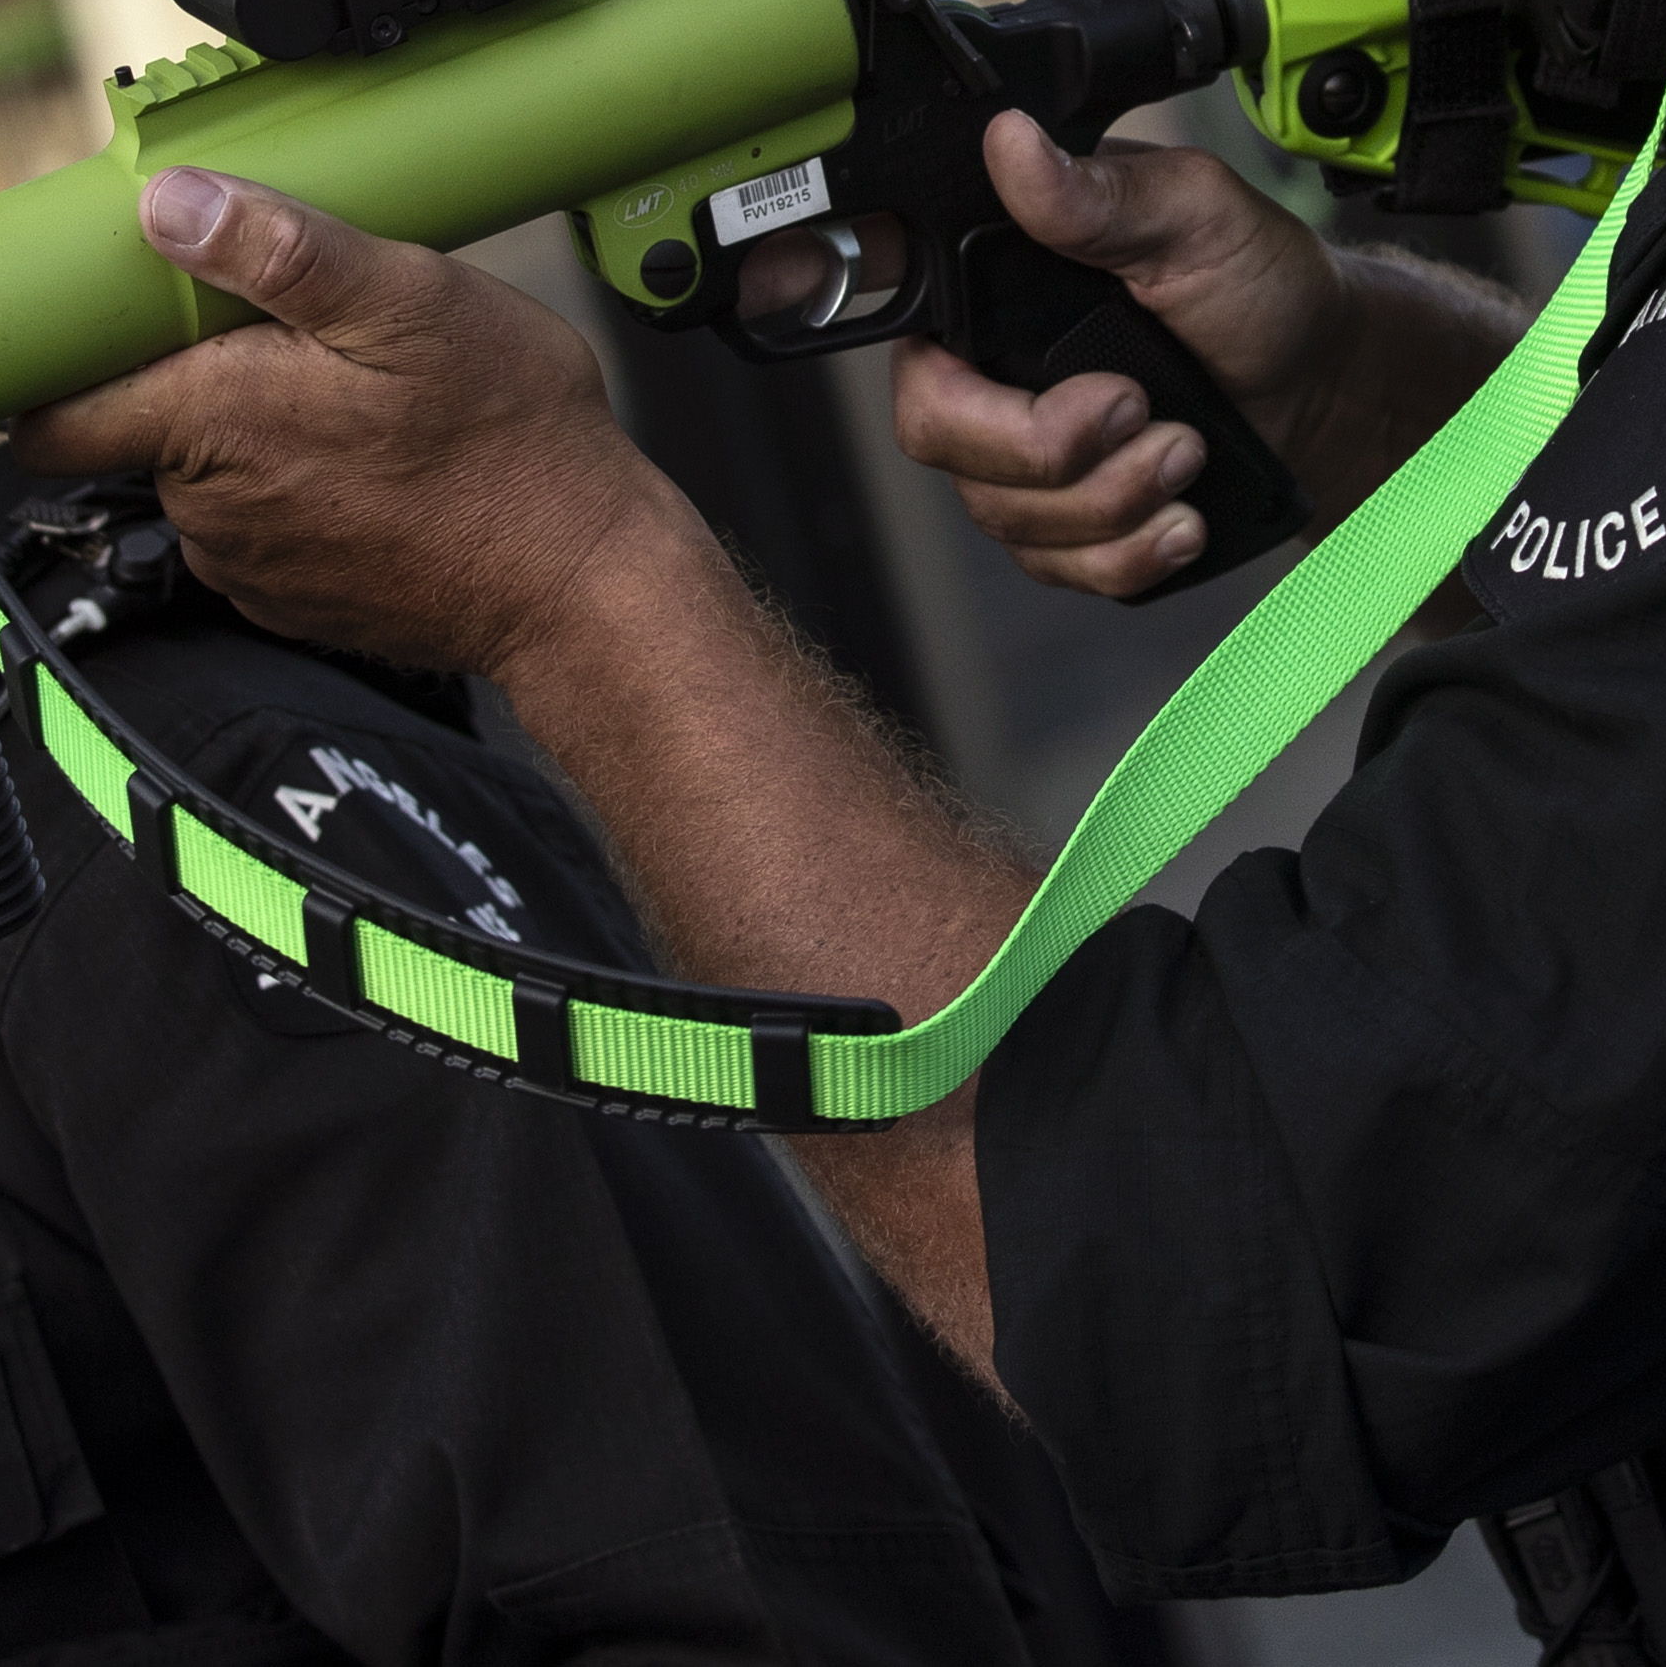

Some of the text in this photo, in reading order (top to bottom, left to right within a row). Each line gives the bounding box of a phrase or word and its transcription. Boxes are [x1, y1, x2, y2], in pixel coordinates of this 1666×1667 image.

[623, 189, 665, 222] LMT
[743, 188, 811, 223] FW19215
[1491, 486, 1666, 580] POLICE
